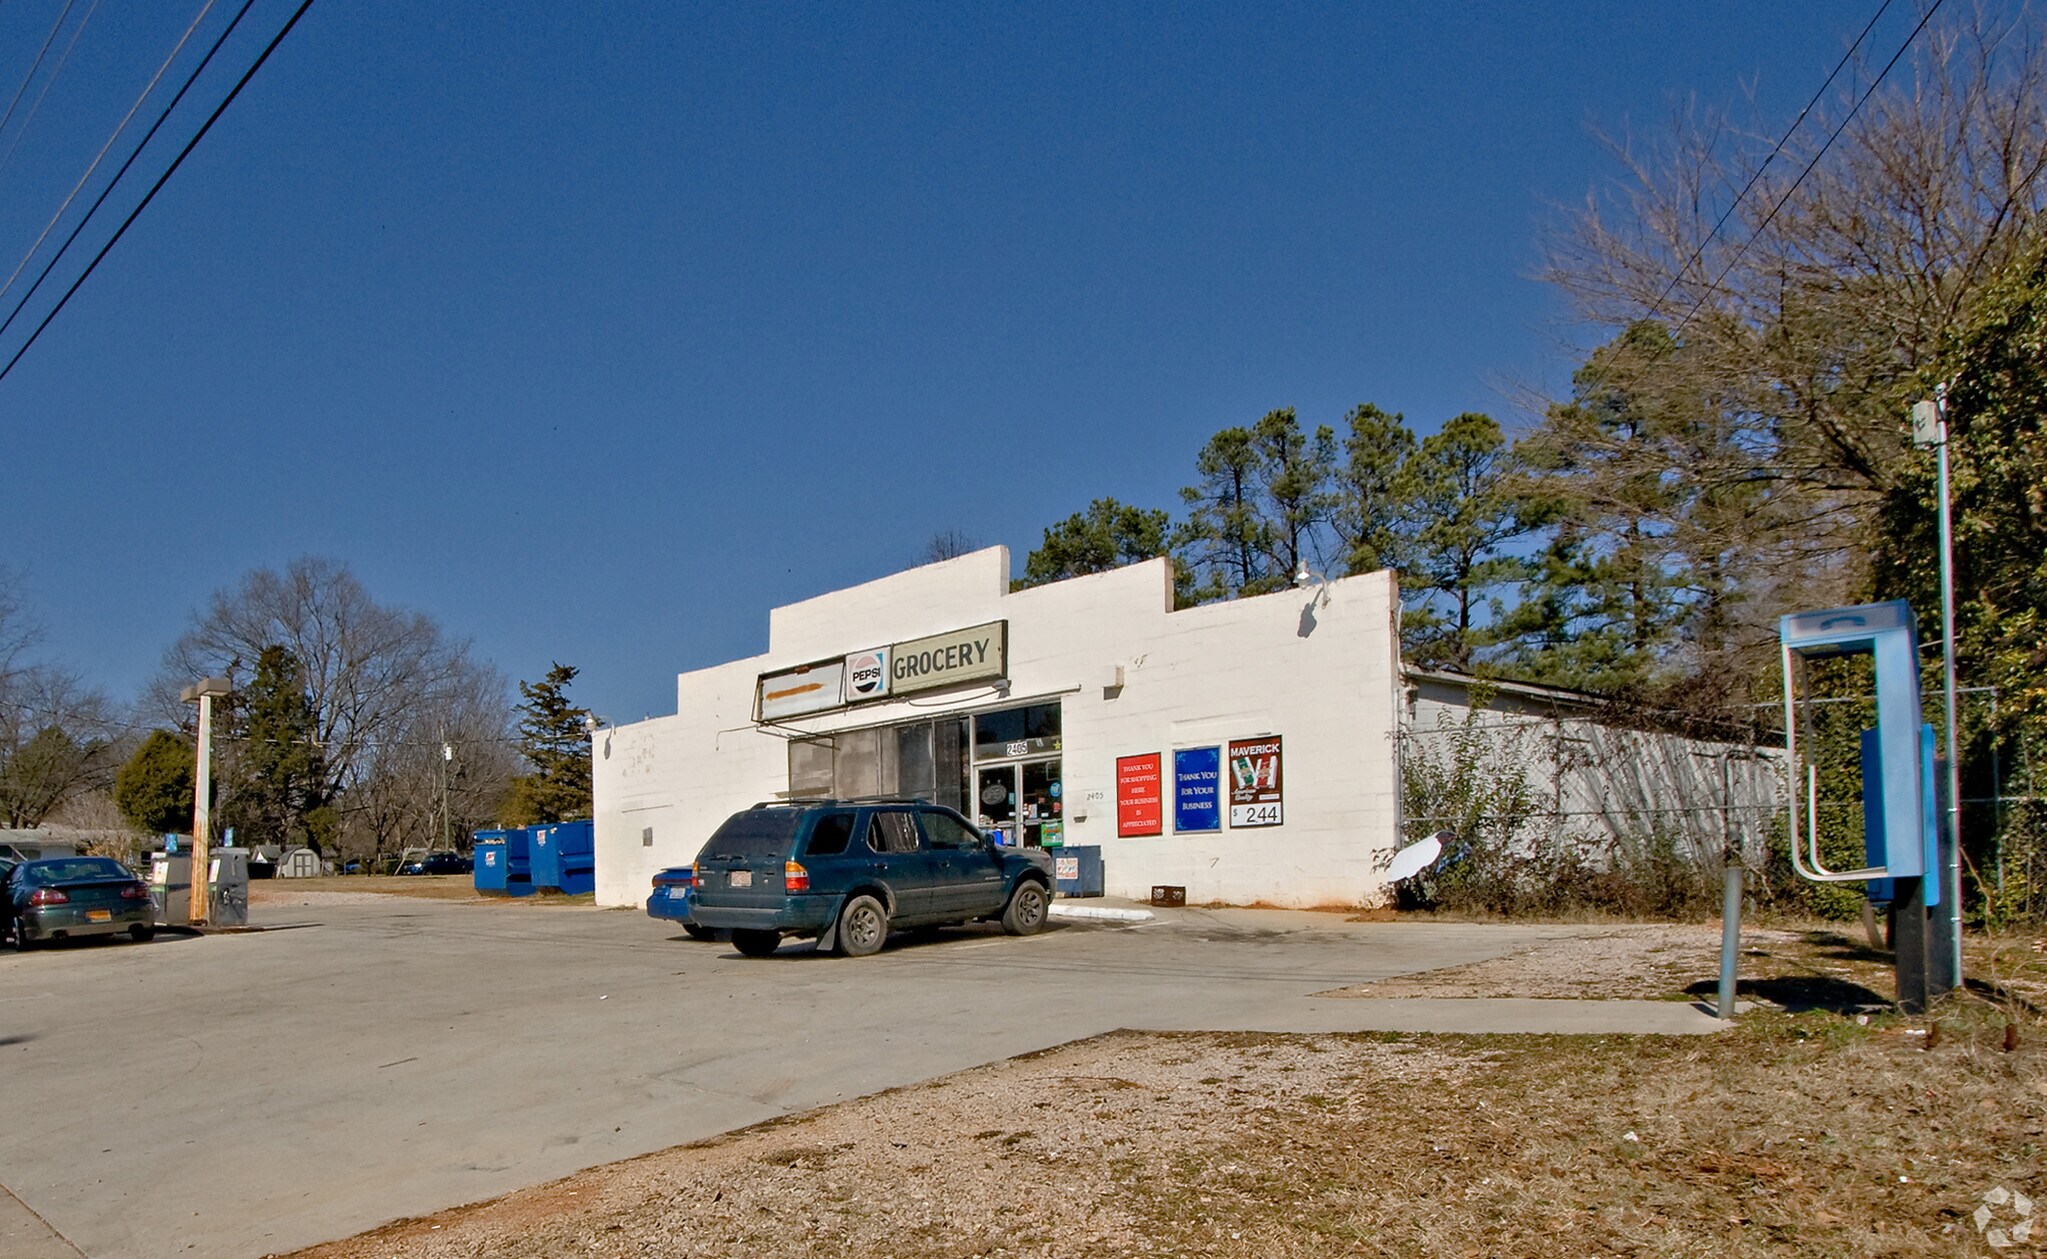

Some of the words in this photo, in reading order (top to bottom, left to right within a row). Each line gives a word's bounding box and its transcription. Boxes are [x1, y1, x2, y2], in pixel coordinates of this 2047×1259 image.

[893, 638, 990, 680] GROCERY
[852, 667, 881, 682] PEPSI
[1007, 742, 1028, 754] 2405
[1230, 743, 1280, 757] MAVERICK
[1123, 764, 1141, 772] THANK
[1130, 774, 1157, 783] SHOPPING
[1177, 773, 1200, 781] THANK
[1201, 771, 1218, 779] YOU
[1181, 787, 1193, 795] FOR
[1193, 786, 1214, 795] YOUR
[1086, 792, 1104, 801] 2405
[1182, 801, 1213, 810] BUSINESS
[1122, 820, 1157, 828] APPRECIATED
